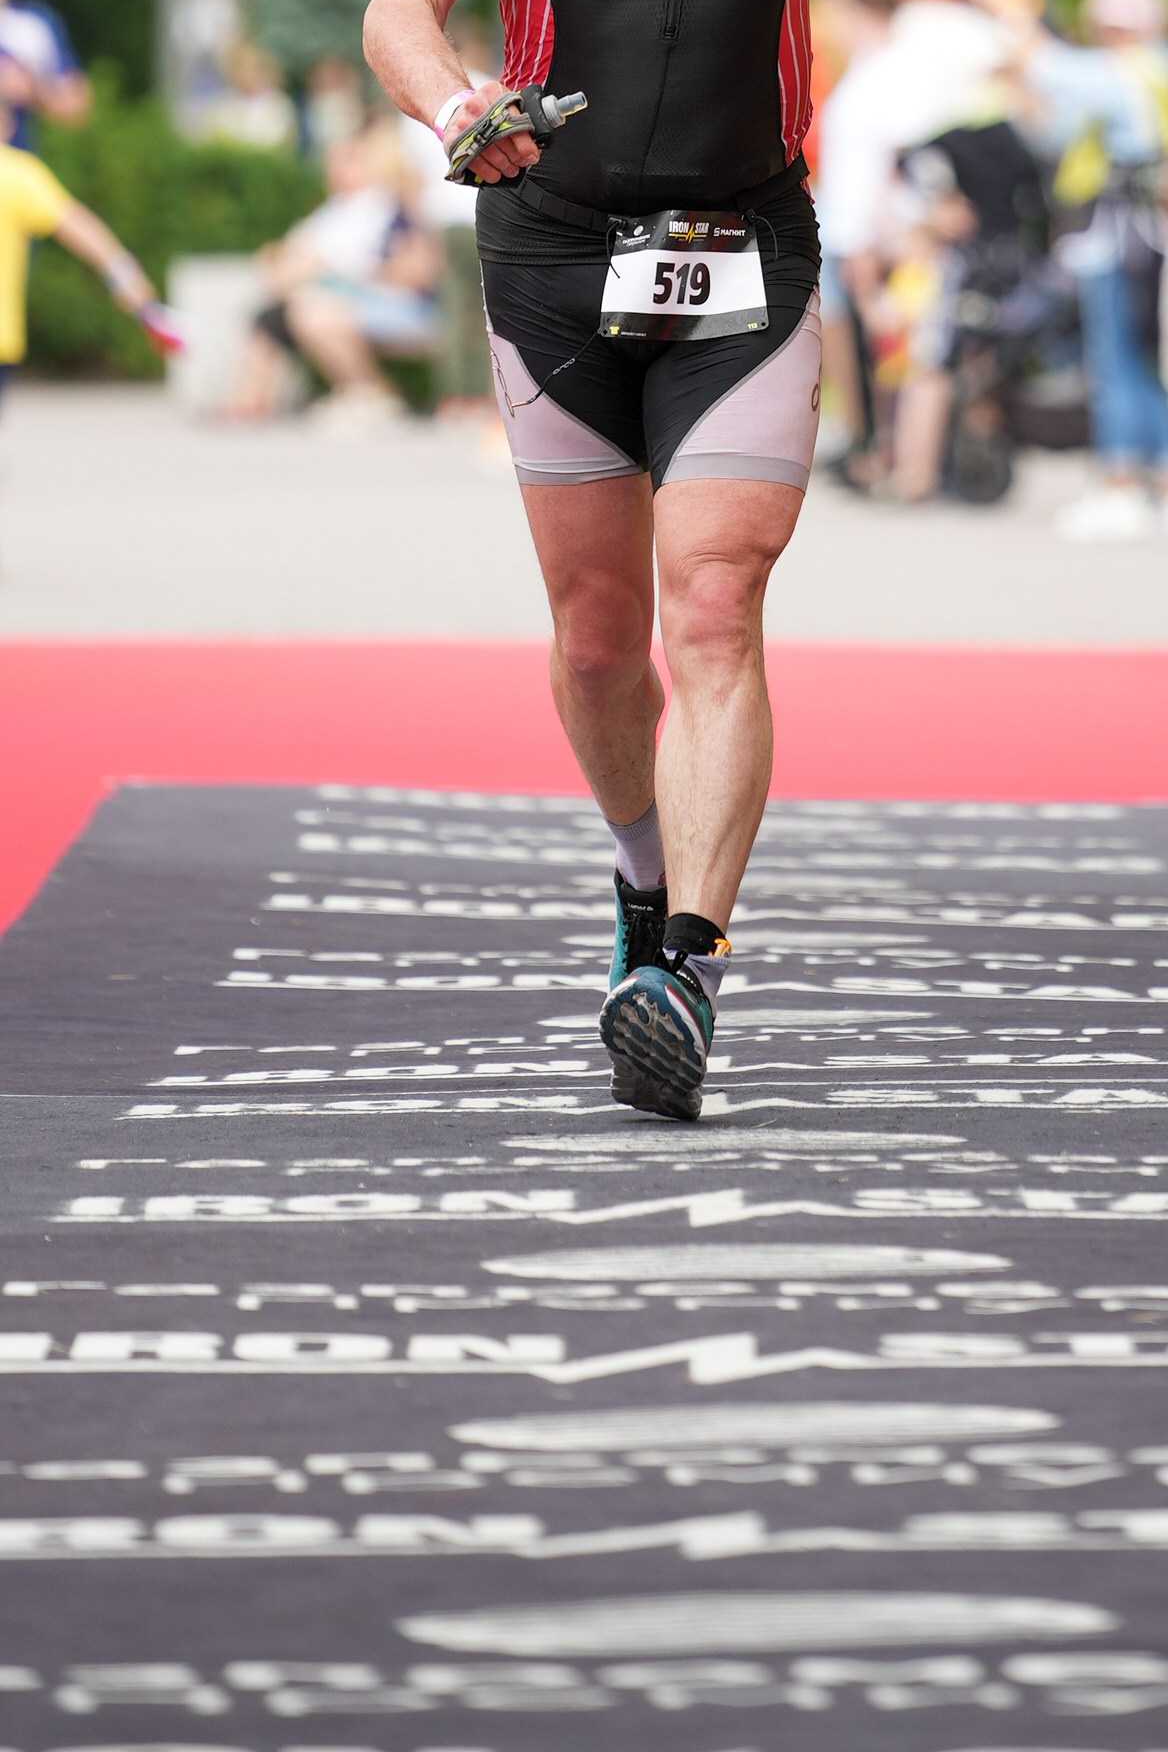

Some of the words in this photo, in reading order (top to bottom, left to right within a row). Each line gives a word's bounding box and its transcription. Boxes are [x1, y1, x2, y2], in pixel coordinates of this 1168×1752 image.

[668, 220, 690, 234] IRON
[694, 222, 710, 234] STAR
[720, 227, 746, 237] МАГНИТ
[652, 262, 711, 306] 519
[156, 1060, 590, 1085] IRON
[127, 1095, 578, 1115] IRON
[69, 1189, 574, 1216] IRON
[0, 1331, 564, 1362] IRON
[0, 1513, 546, 1548] RON
